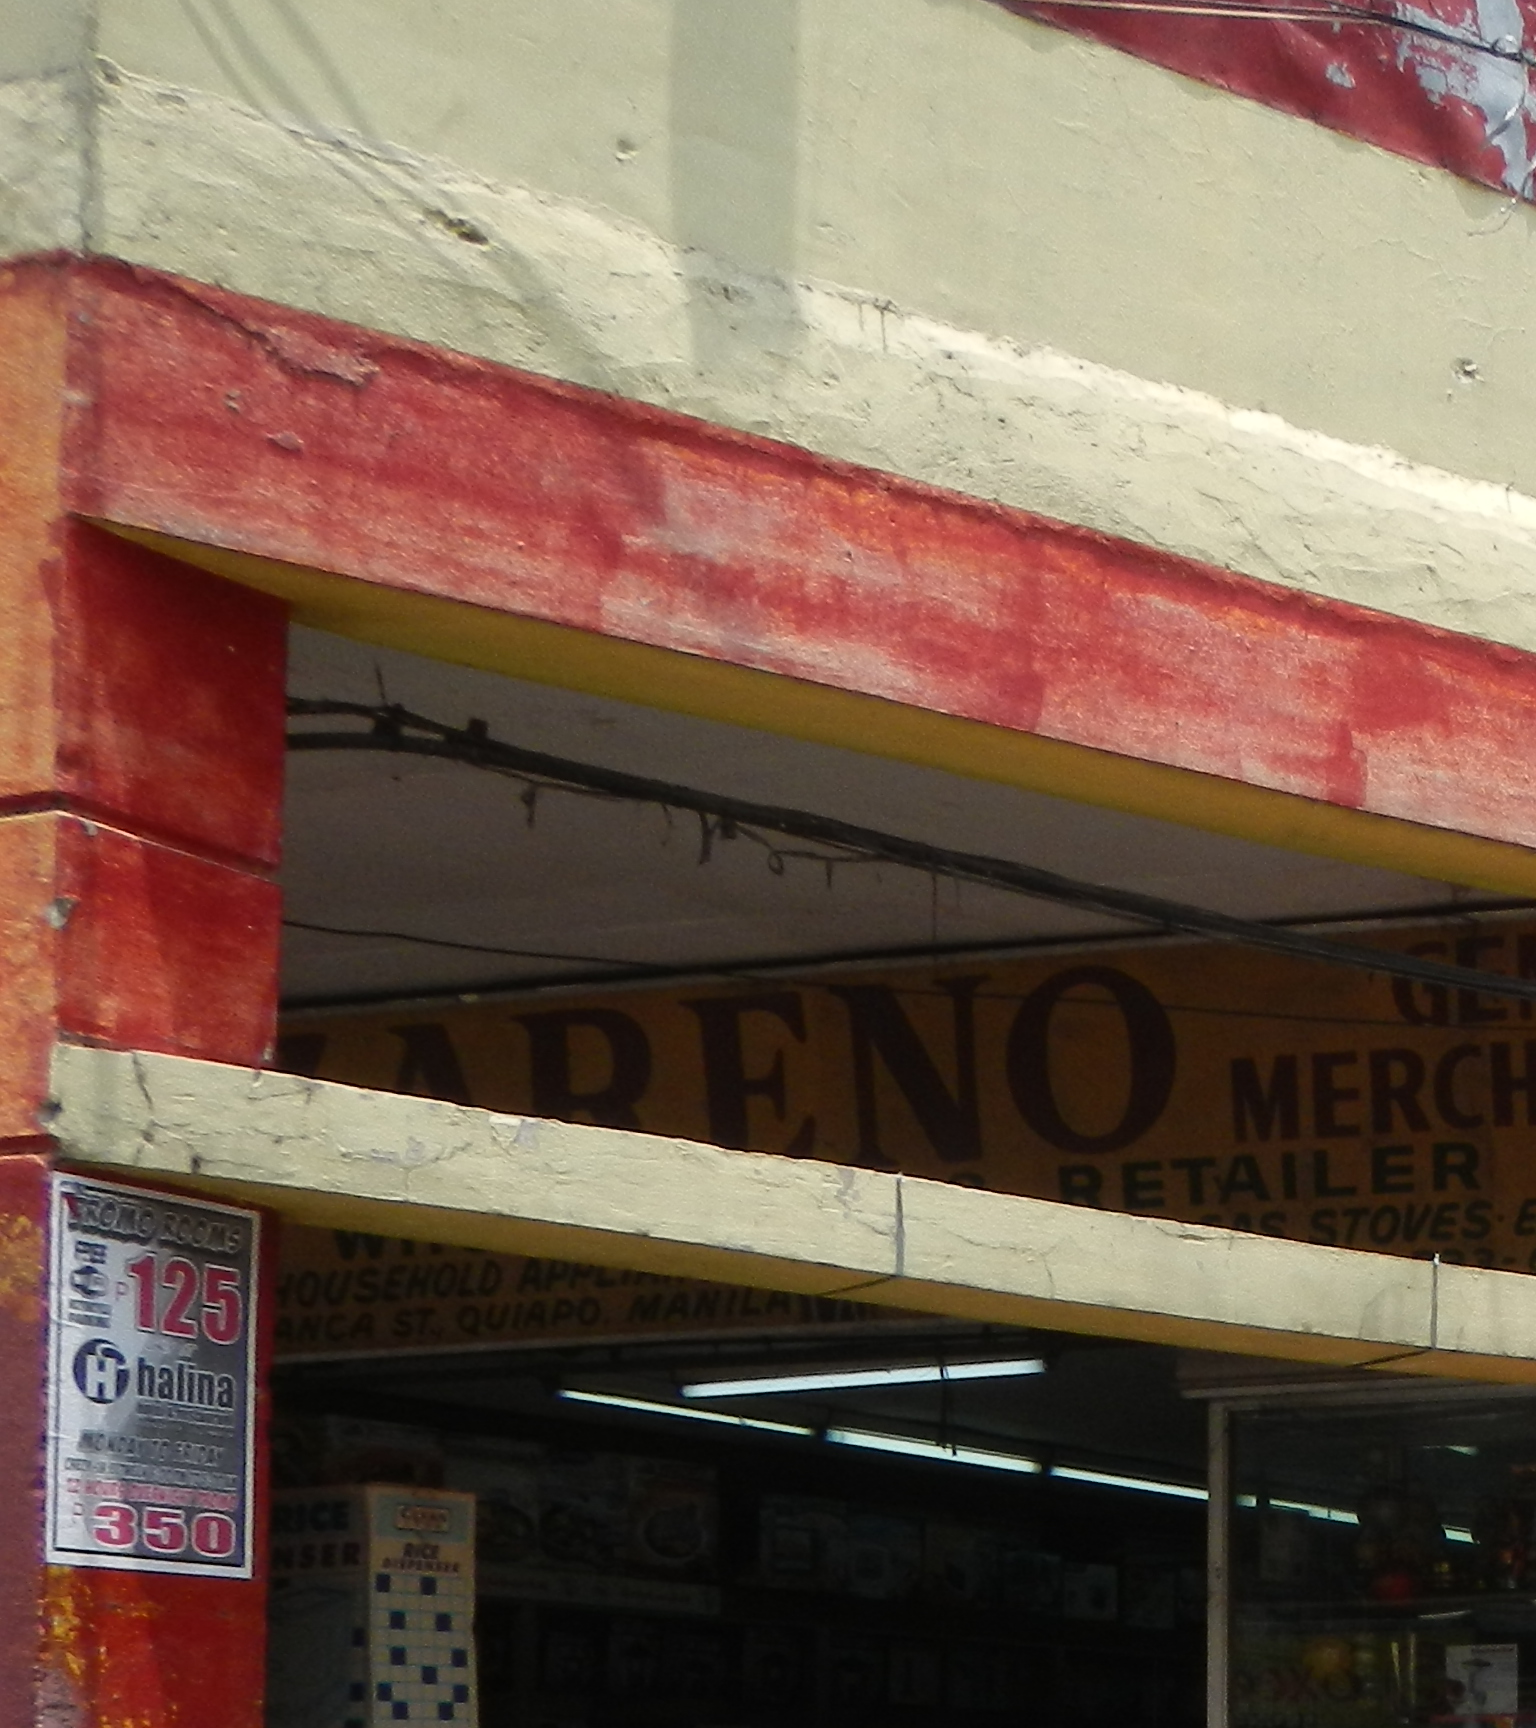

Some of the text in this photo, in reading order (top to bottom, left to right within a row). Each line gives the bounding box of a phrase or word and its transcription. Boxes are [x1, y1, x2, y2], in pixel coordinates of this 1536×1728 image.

[1058, 1142, 1482, 1209] RETAILER
[125, 1252, 242, 1346] 125
[136, 1356, 236, 1410] halina
[92, 1501, 237, 1558] 350
